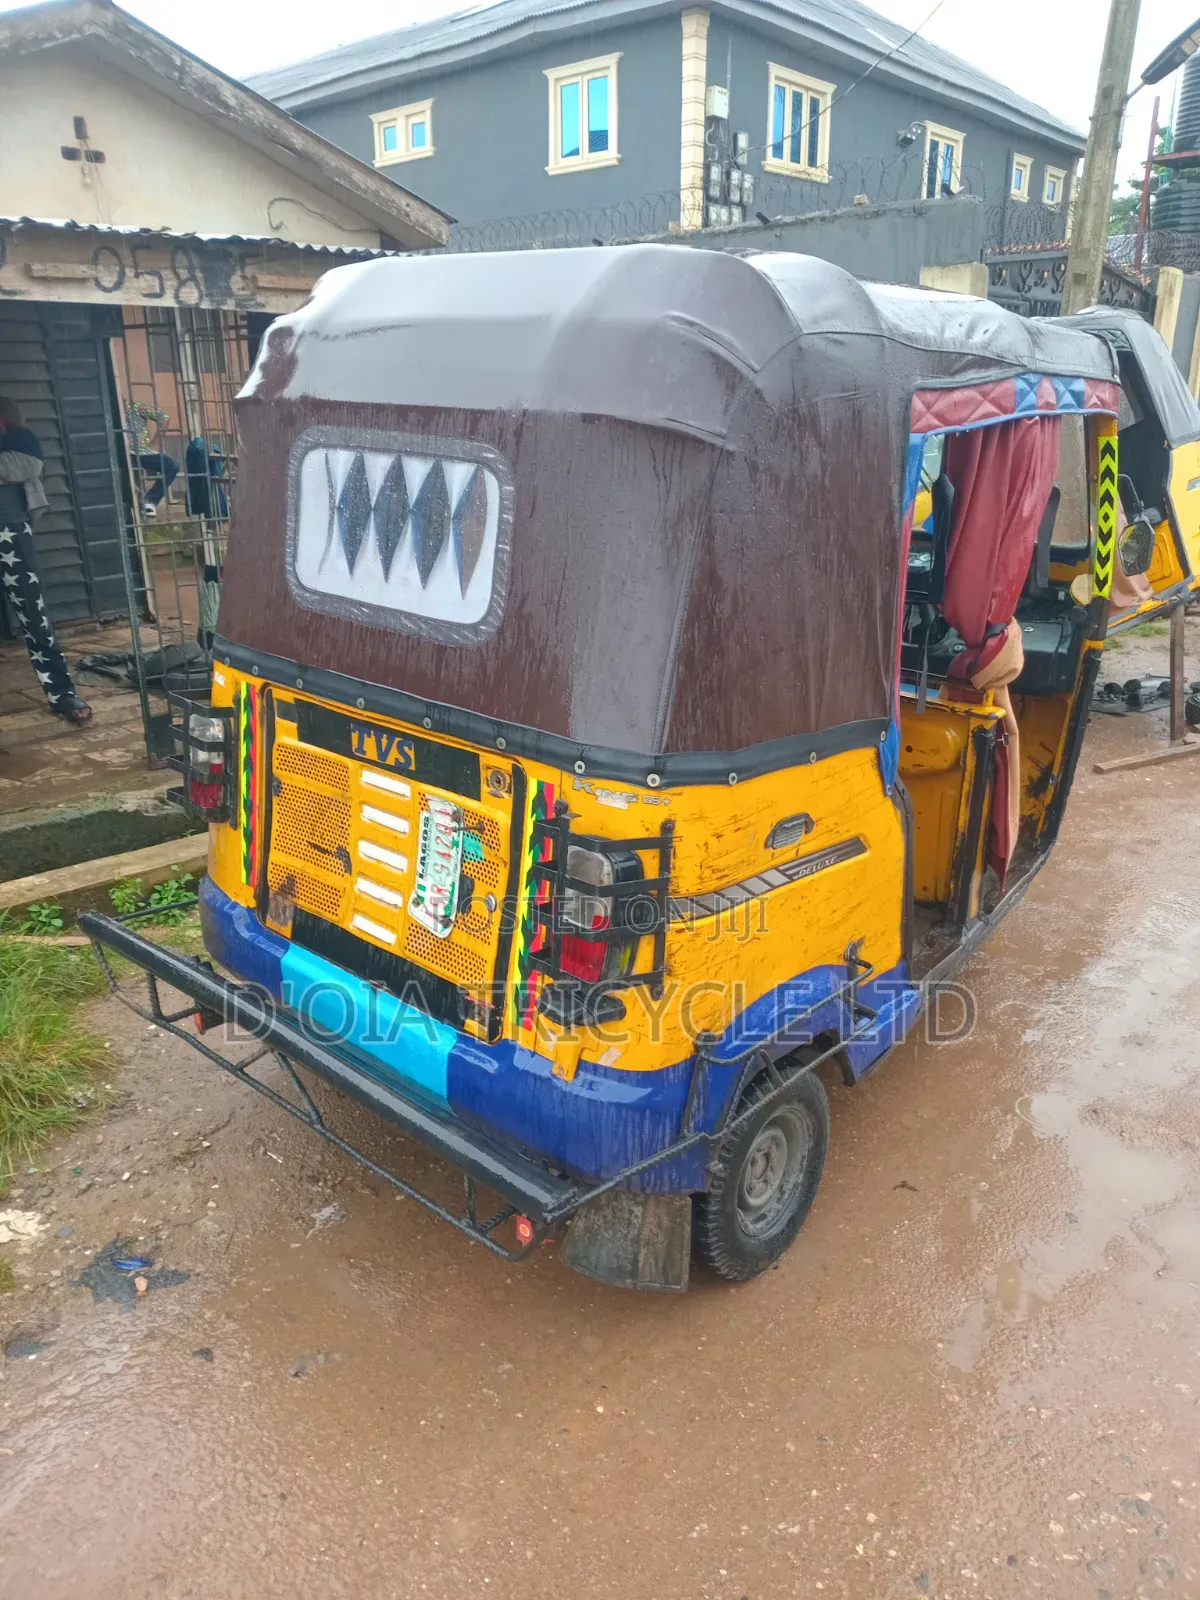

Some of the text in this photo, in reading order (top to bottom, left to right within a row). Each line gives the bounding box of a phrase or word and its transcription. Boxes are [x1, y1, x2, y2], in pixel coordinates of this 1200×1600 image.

[351, 724, 413, 770] TVS
[418, 815, 430, 880] LAGOS
[798, 856, 838, 878] DELUXE
